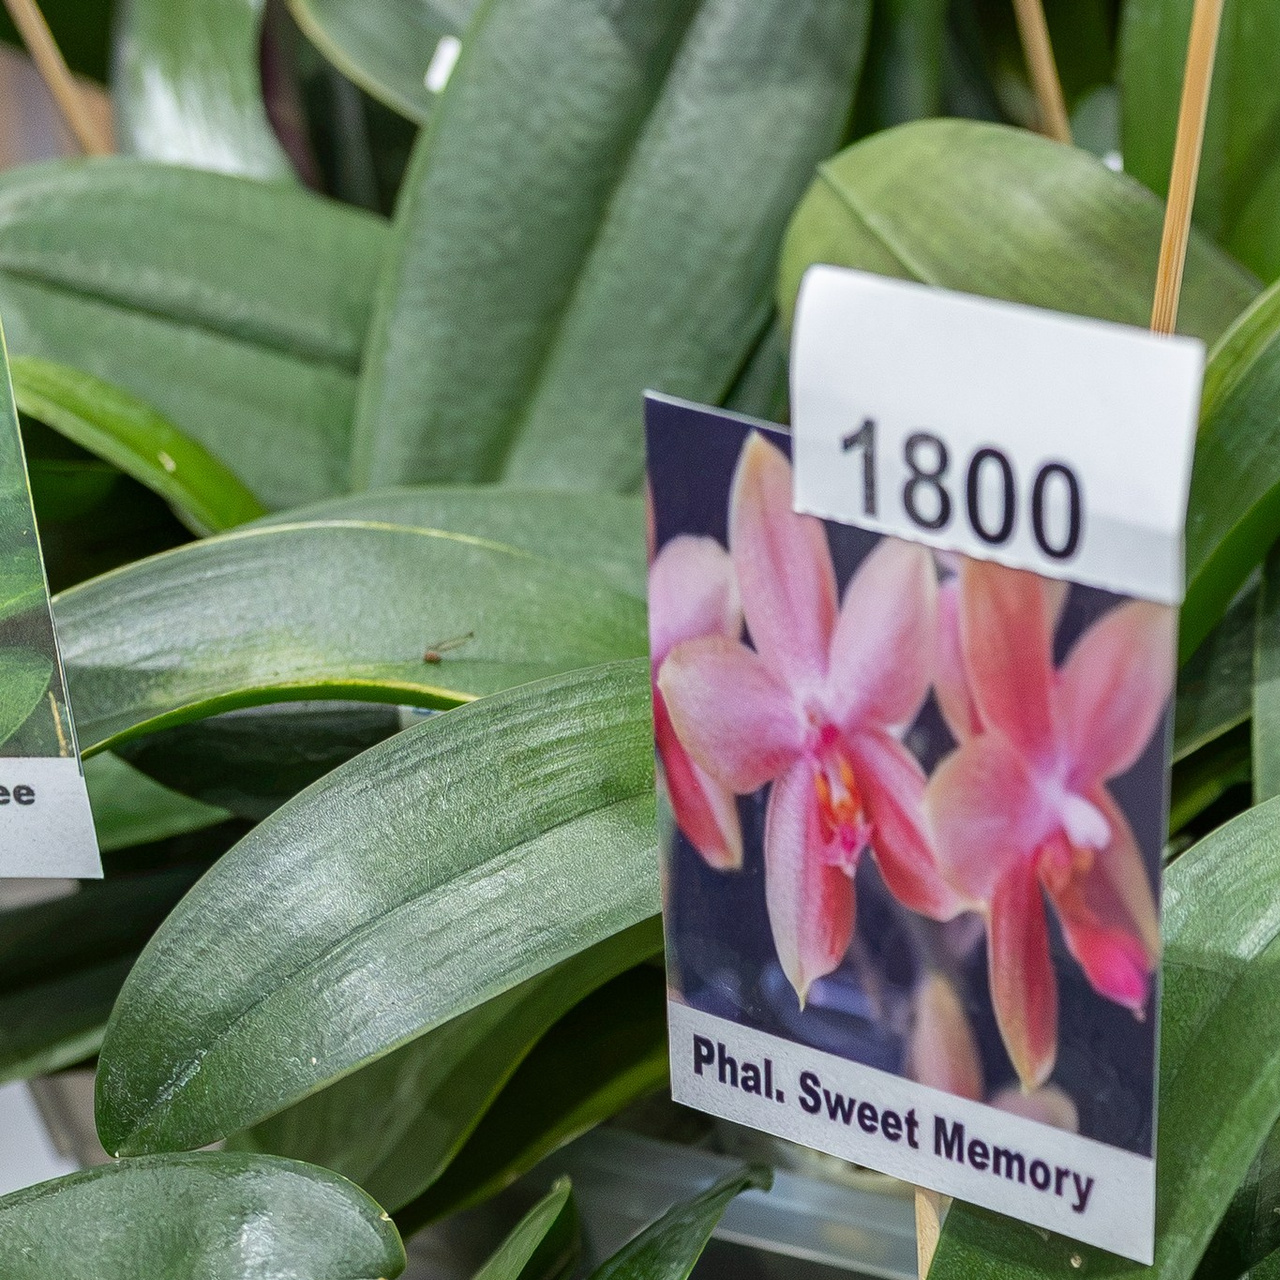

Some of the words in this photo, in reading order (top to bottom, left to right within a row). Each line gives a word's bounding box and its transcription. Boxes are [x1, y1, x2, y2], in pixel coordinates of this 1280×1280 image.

[842, 418, 1082, 560] 1800
[691, 1032, 786, 1104] Phal.
[797, 1070, 921, 1150] Sweet
[932, 1113, 1095, 1214] Memory
